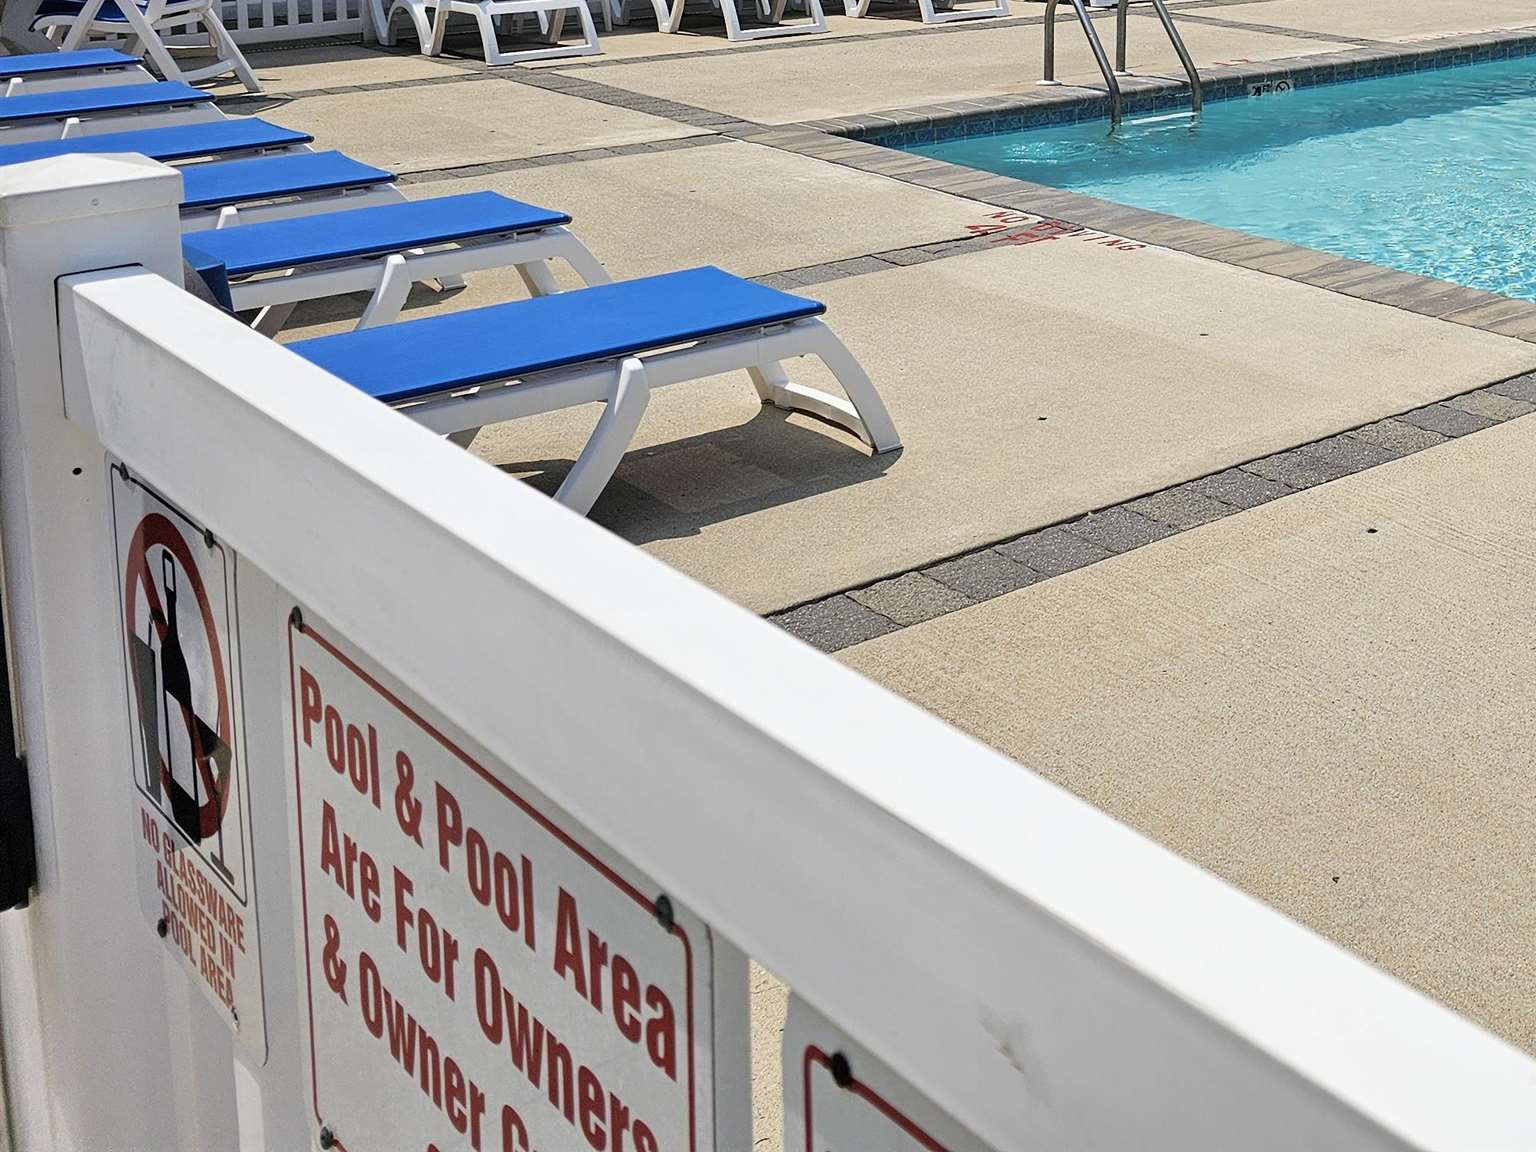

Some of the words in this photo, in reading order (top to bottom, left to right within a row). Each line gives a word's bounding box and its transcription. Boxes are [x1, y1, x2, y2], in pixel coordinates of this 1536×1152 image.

[982, 211, 1030, 224] NO
[141, 807, 160, 853] NO
[163, 831, 246, 954] GLASSWARE
[156, 858, 217, 955] ALLOWED
[219, 931, 235, 980] IN
[299, 665, 382, 810] Pool
[395, 750, 424, 849] &
[434, 780, 536, 952] Pool
[553, 885, 677, 1083] Area
[320, 798, 382, 923] Are
[393, 864, 460, 1003] For
[162, 899, 197, 967] POOL
[200, 945, 234, 1010] AREA
[322, 913, 348, 1006] &
[358, 950, 486, 1148] Owner
